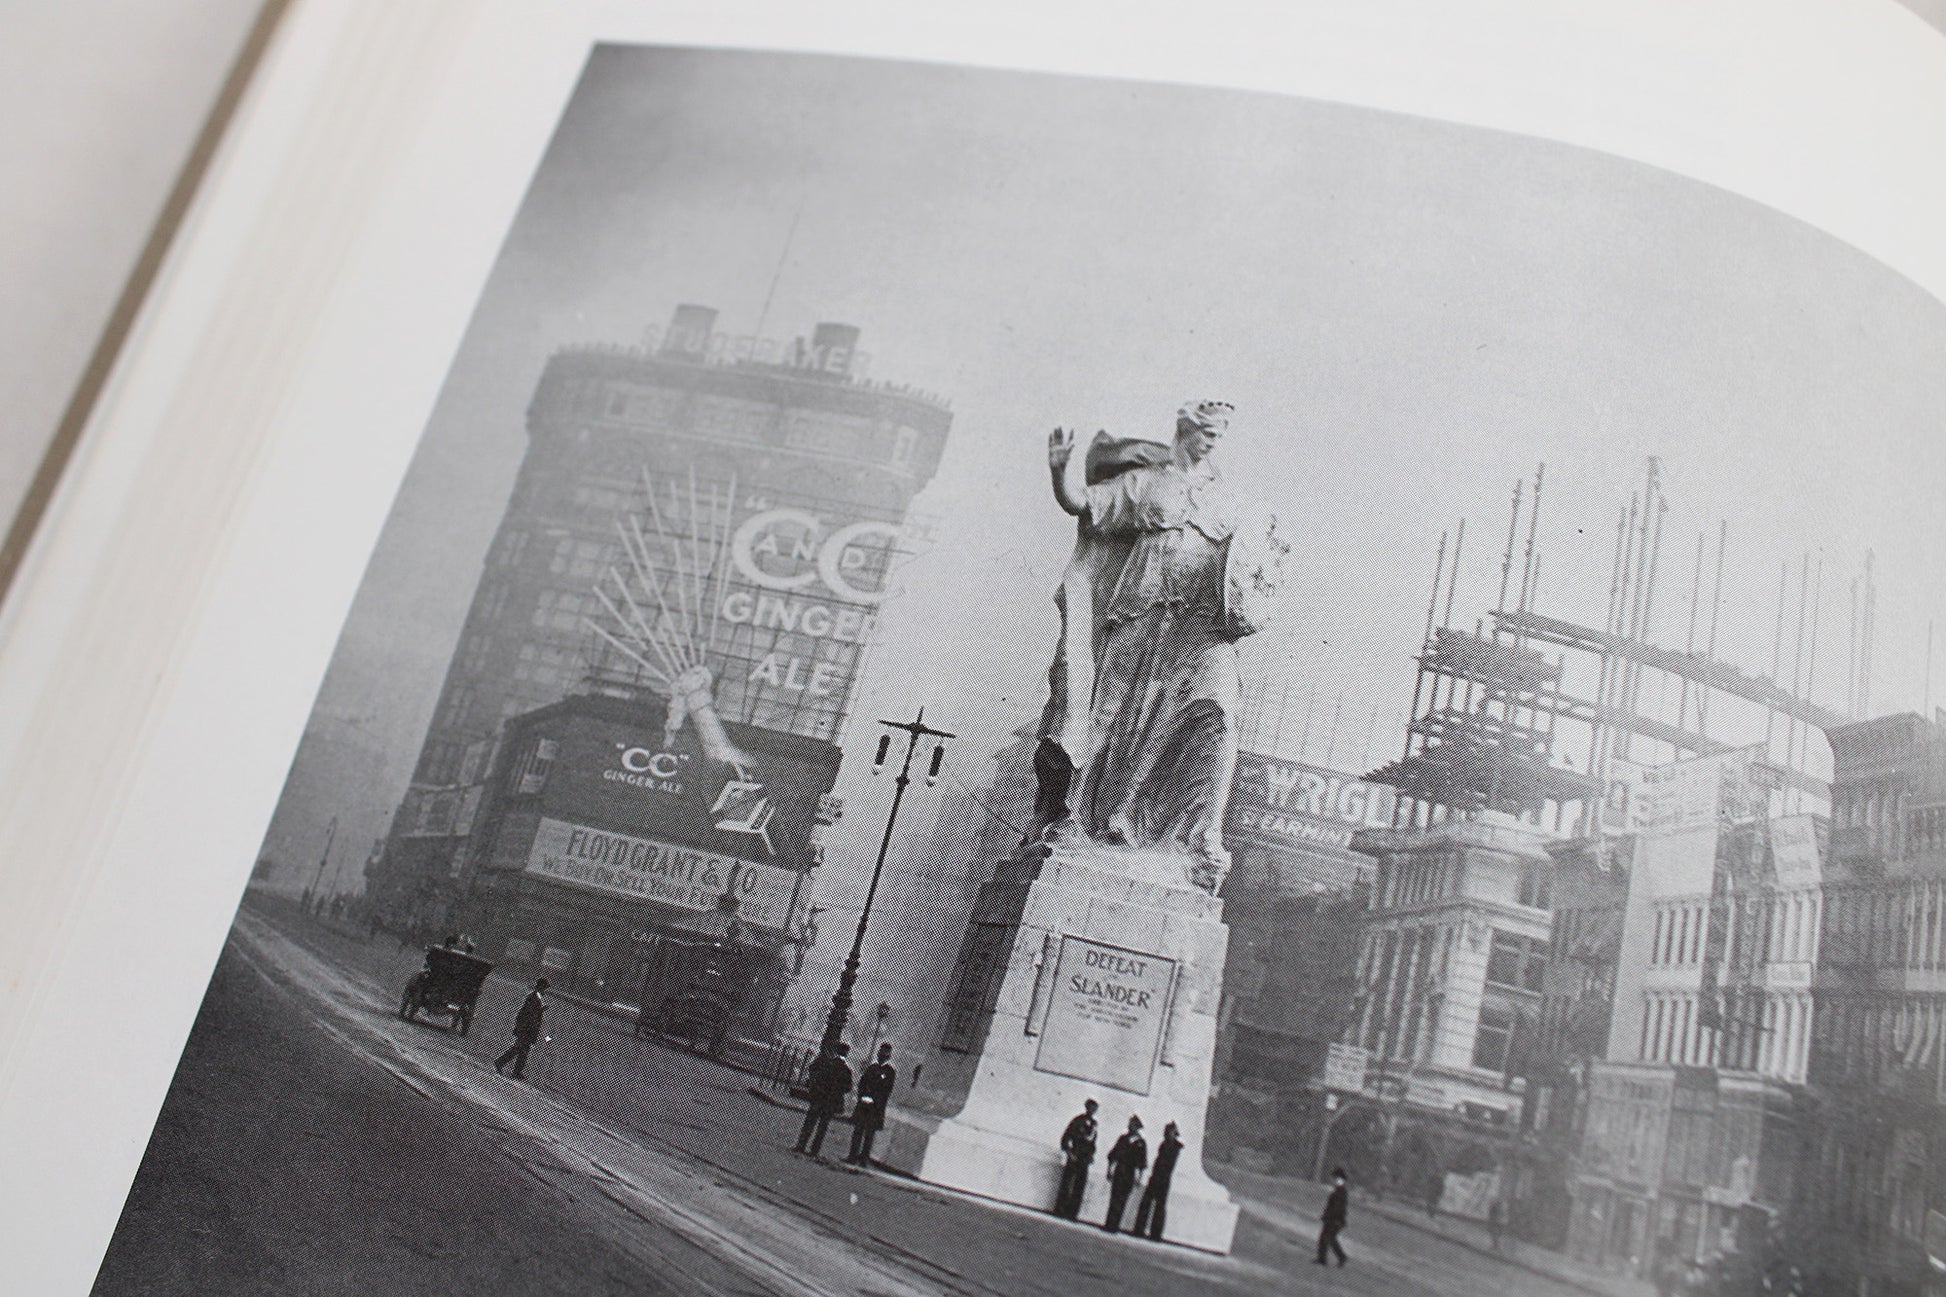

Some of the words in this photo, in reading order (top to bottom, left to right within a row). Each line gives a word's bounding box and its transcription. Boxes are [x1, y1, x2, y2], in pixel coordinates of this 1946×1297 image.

[748, 653, 836, 696] ALE
[603, 769, 655, 790] GINGER
[542, 854, 562, 875] WE
[564, 859, 595, 880] BUY
[615, 870, 647, 892] SELL
[649, 878, 686, 903] YOUR
[566, 829, 630, 866] FLOYD
[630, 842, 704, 882] GRANT
[701, 858, 721, 887] &
[1085, 949, 1148, 978] DEFEAT
